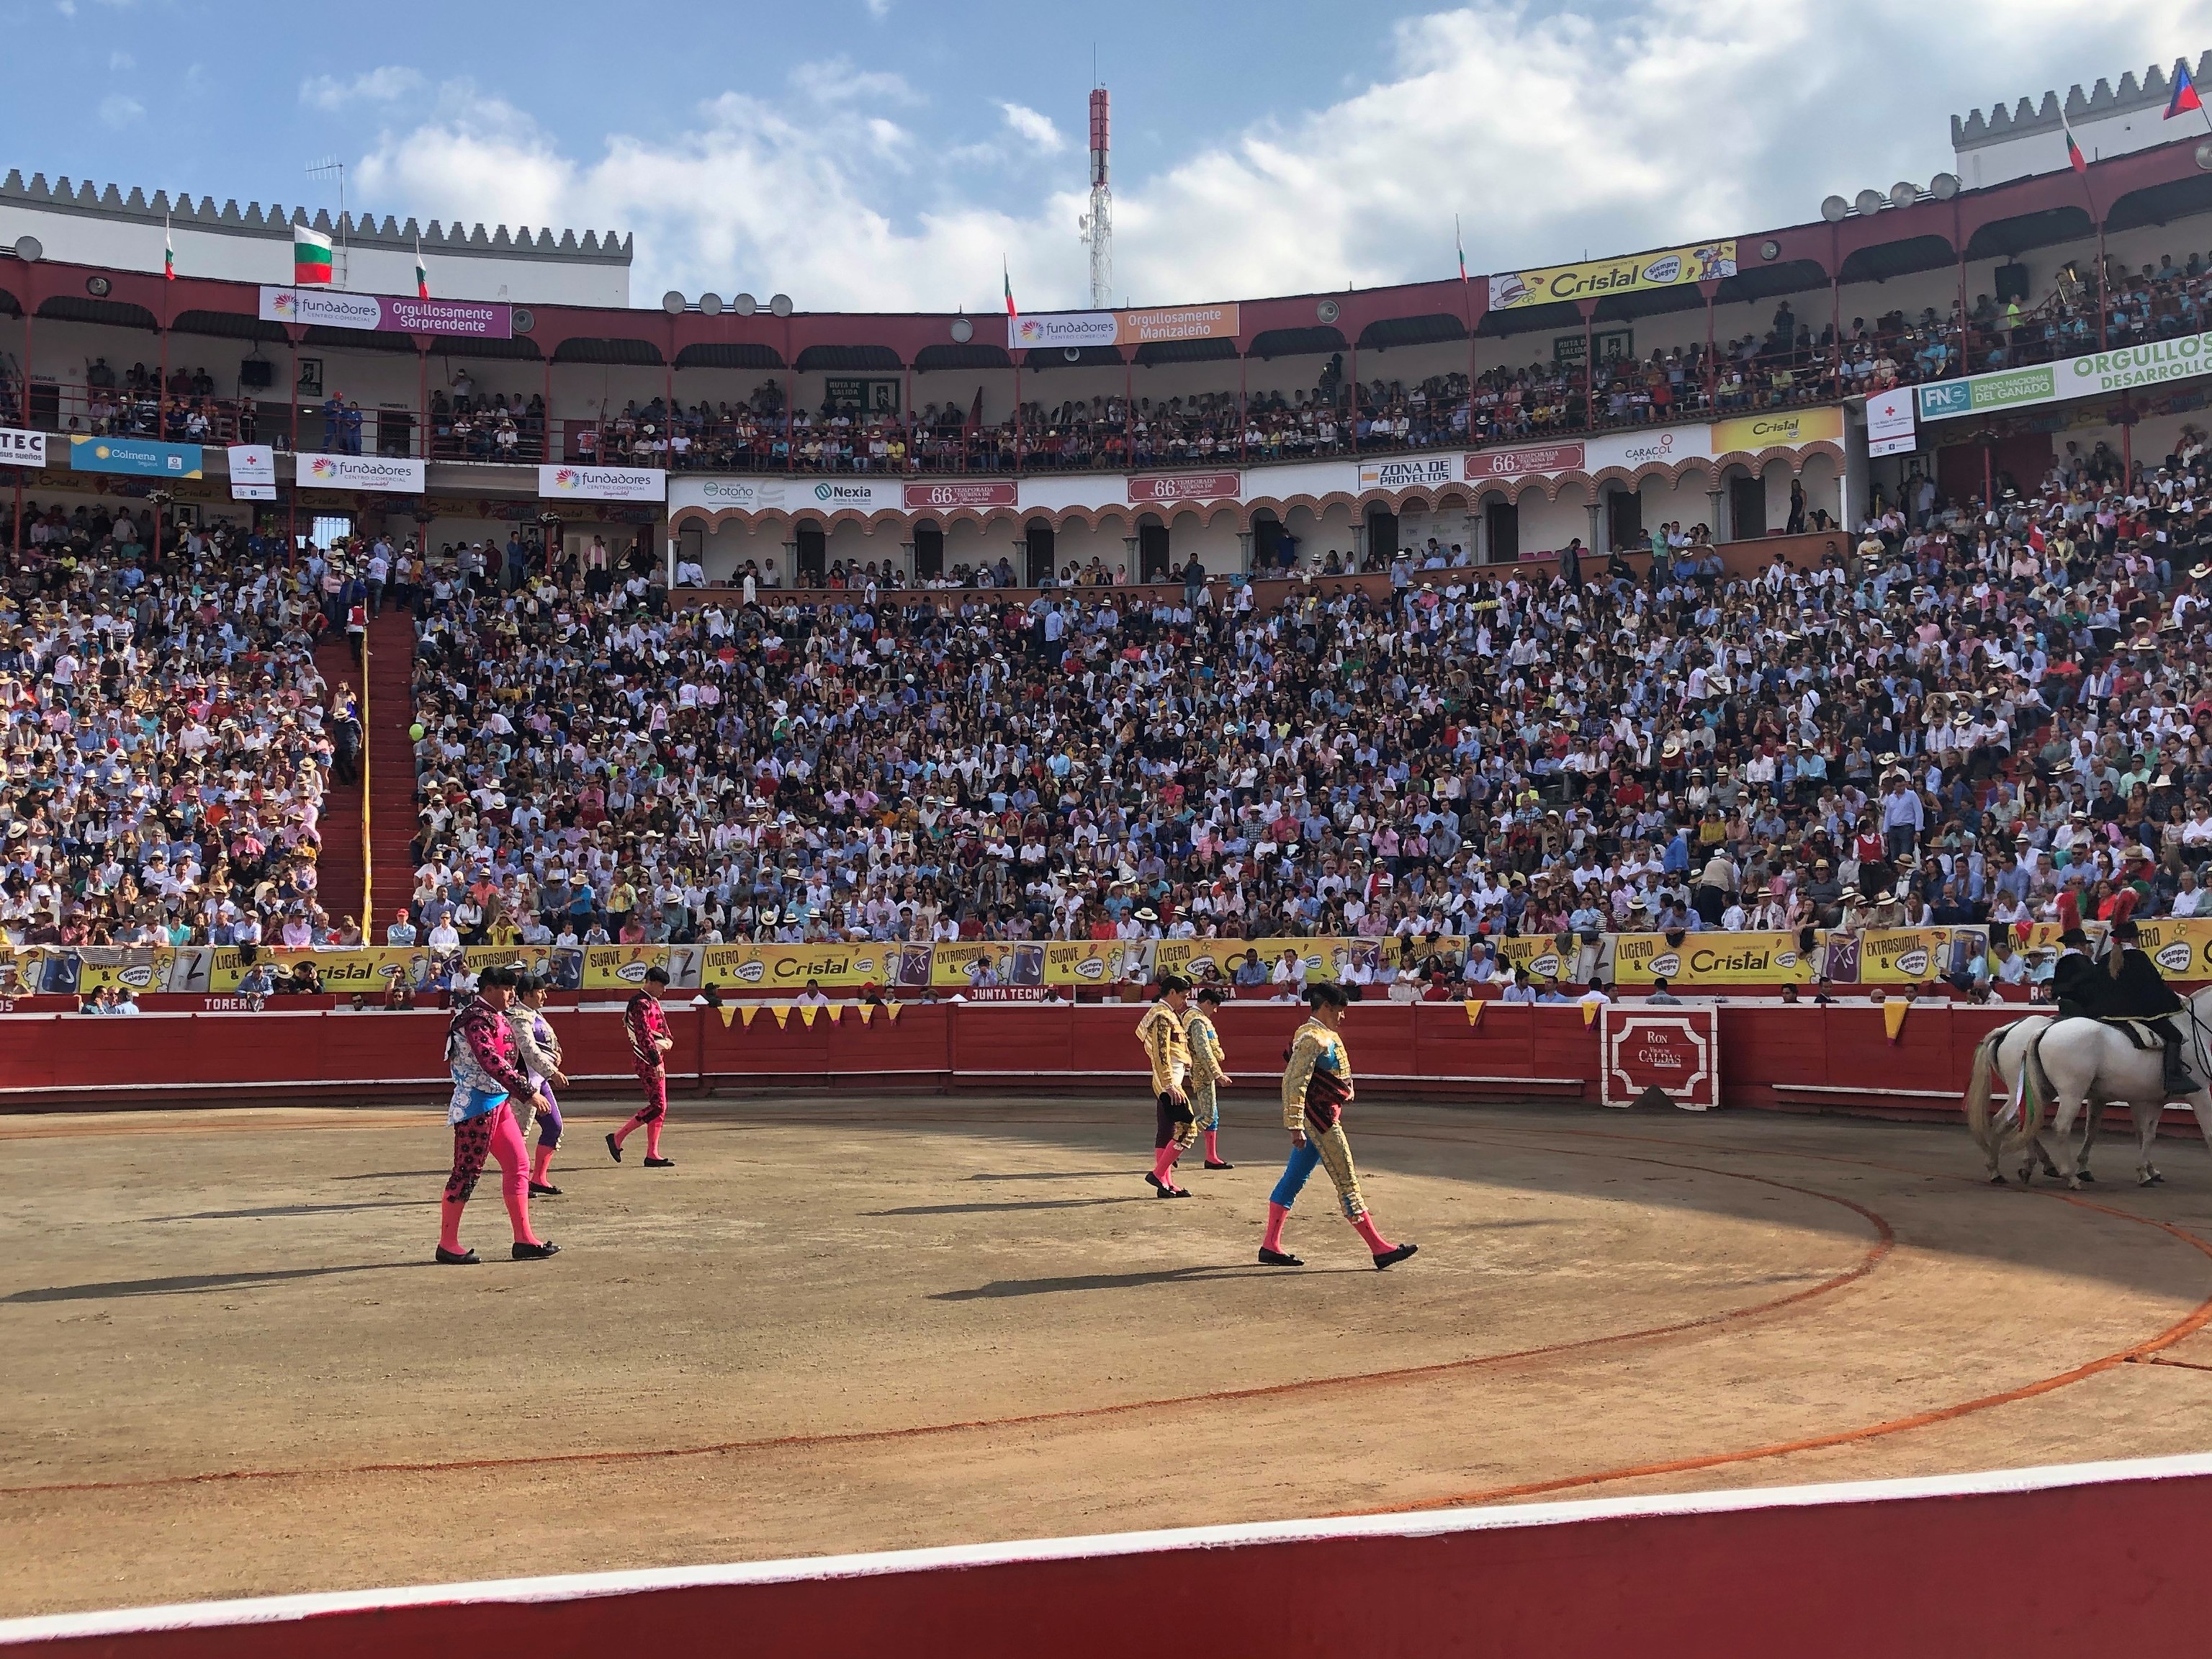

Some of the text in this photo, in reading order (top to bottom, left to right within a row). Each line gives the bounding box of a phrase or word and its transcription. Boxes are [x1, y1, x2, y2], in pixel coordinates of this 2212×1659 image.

[1649, 260, 1678, 275] Siempre
[1654, 268, 1676, 279] alegre
[1550, 265, 1639, 298] Cristal
[302, 298, 377, 316] fundadores
[392, 302, 493, 320] Orgullosamente
[335, 314, 371, 323] COMERCIAL
[400, 315, 485, 332] Sorprendente
[1128, 310, 1221, 326] Orgullosamente
[1046, 322, 1114, 336] fundadores
[1141, 323, 1210, 339] Manizaleño
[1558, 340, 1578, 349] RUTA
[1974, 374, 2049, 392] FONDO NACIONAL
[1925, 385, 1966, 408] FNG
[1975, 382, 2050, 403] DEL GANADO
[1753, 419, 1799, 435] Cristal
[15, 451, 42, 462] sueños
[112, 449, 156, 462] Colmena
[1516, 451, 1559, 460] TEMPORADA
[1625, 446, 1672, 459] CARACOL
[339, 462, 412, 477] fundadores
[1380, 460, 1449, 477] ZONA DE
[1493, 454, 1514, 472] 66
[39, 472, 78, 487] Cristal
[583, 472, 651, 485] fundadores
[1380, 472, 1449, 485] PROYECTOS
[173, 487, 211, 498] Cristal
[719, 485, 753, 496] otoño
[834, 486, 871, 498] Nexia
[1155, 480, 1175, 497] 66
[302, 495, 339, 505] Cristal
[932, 487, 952, 504] 66
[1503, 942, 1534, 959] SUAVE
[1619, 940, 1653, 960] LIGERO
[1866, 935, 1920, 957] EXTRASUAVE
[469, 950, 520, 968] EXTRASUAVE
[590, 950, 621, 968] SUAVE
[706, 950, 739, 967] LIGERO
[937, 946, 985, 964] EXTRASUAVE
[1050, 947, 1079, 964] SUAVE
[1159, 945, 1191, 962] LIGERO
[1833, 938, 1858, 968] XS
[2161, 945, 2189, 961] Siempre
[907, 949, 930, 974] XS
[1080, 962, 1102, 971] Siempre
[1172, 962, 1180, 972] &
[1191, 960, 1213, 970] Siempre
[1516, 961, 1523, 970] &
[1534, 959, 1557, 968] Siempre
[1633, 960, 1642, 971] &
[1654, 958, 1678, 968] Siempre
[1691, 950, 1769, 972] Cristal
[1881, 958, 1889, 968] &
[1901, 956, 1926, 966] Siempre
[1905, 961, 1925, 970] alegre
[2164, 956, 2188, 966] alegre
[124, 968, 150, 979] Siempre
[602, 968, 610, 977] &
[622, 964, 645, 974] Siempre
[720, 968, 727, 976] &
[739, 965, 763, 974] Siempre
[774, 958, 849, 978] Cristal
[950, 964, 957, 974] &
[1061, 964, 1069, 974] &
[102, 972, 110, 981] &
[231, 970, 238, 980] &
[972, 989, 1007, 1000] JUNTA
[1638, 1050, 1681, 1064] CALDAS
